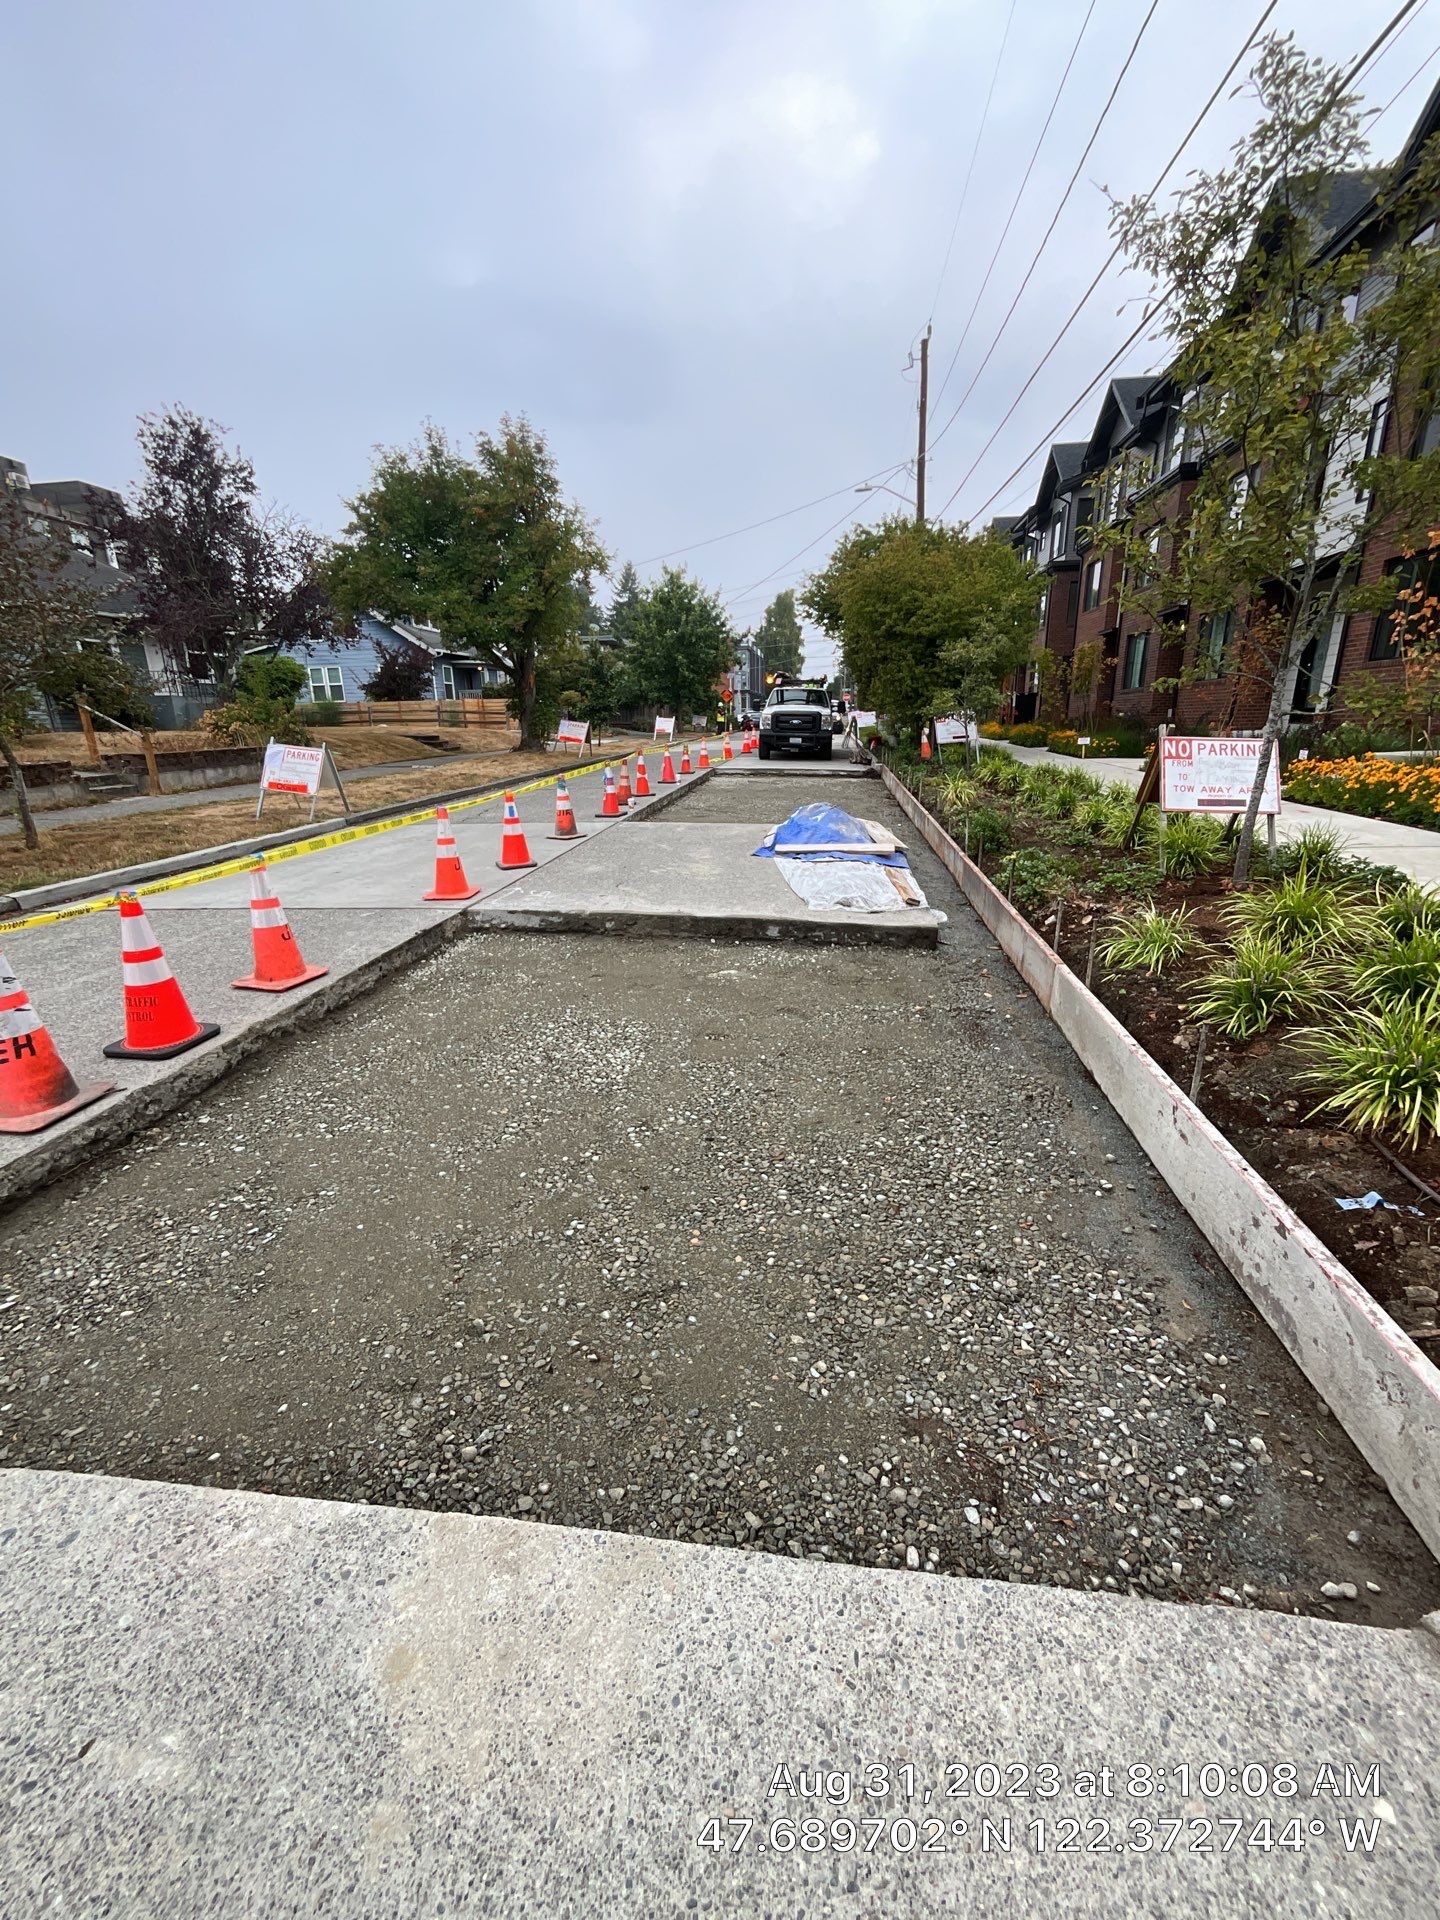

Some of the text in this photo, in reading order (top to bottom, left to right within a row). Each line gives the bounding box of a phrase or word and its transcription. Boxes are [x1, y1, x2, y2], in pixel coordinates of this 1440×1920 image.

[1164, 740, 1191, 757] NO
[286, 750, 320, 762] PARKING
[1178, 773, 1188, 781] TO
[1173, 785, 1269, 795] TOW AWAY ARA
[126, 996, 159, 1007] RAFFIC
